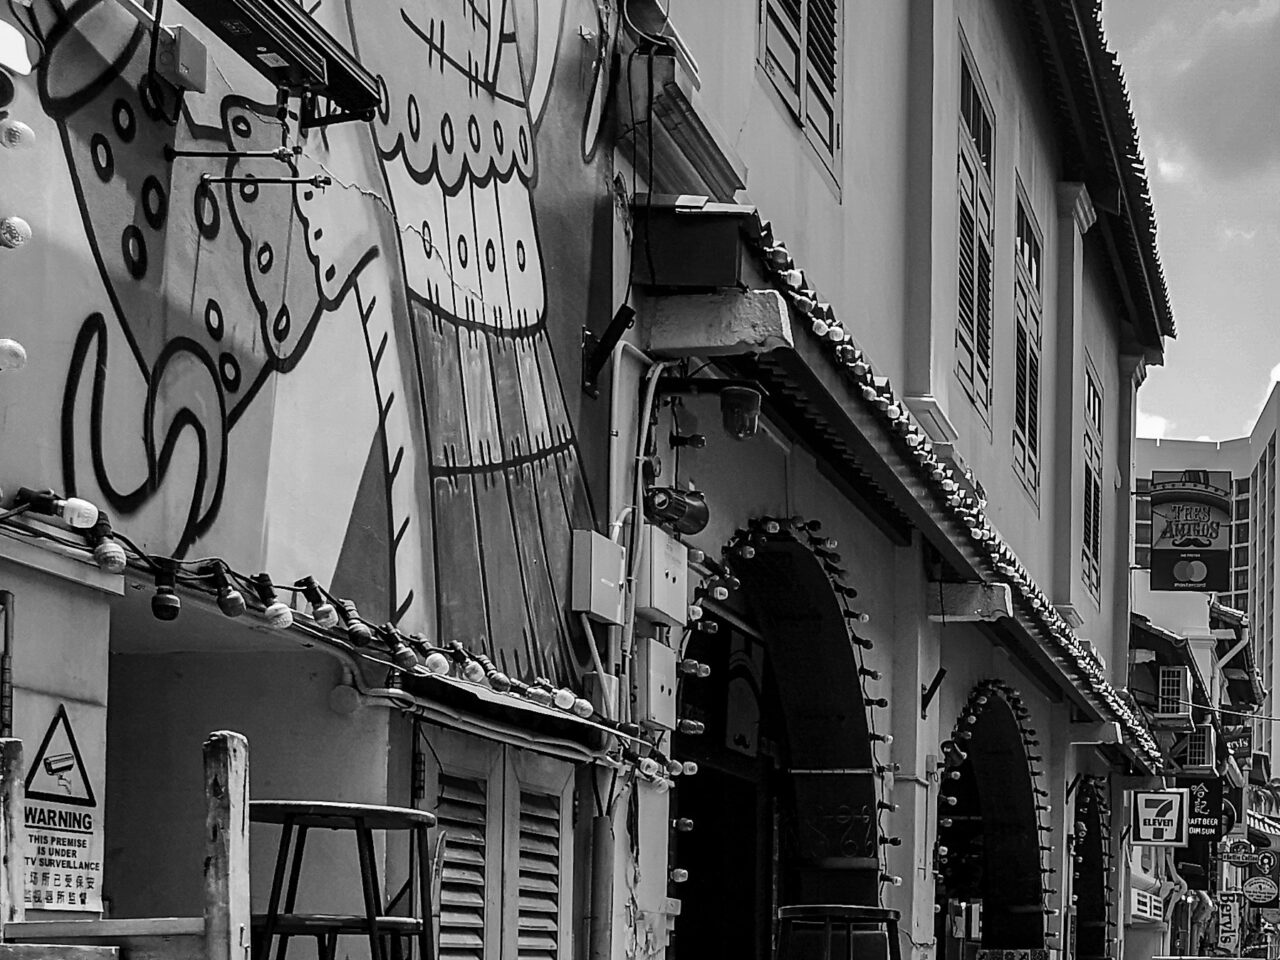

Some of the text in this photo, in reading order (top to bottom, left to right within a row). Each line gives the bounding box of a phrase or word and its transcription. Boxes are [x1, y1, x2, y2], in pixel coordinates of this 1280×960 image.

[1144, 798, 1175, 819] 7
[24, 806, 92, 830] WARNING
[1188, 817, 1202, 825] AFT
[1189, 826, 1201, 835] DIM
[29, 834, 87, 848] THIS PREMISE
[37, 846, 77, 859] IS UNDER
[24, 856, 100, 872] TV SURVEILLANCE
[24, 871, 95, 890] 场所已受保安
[1219, 893, 1237, 944] Beryl's
